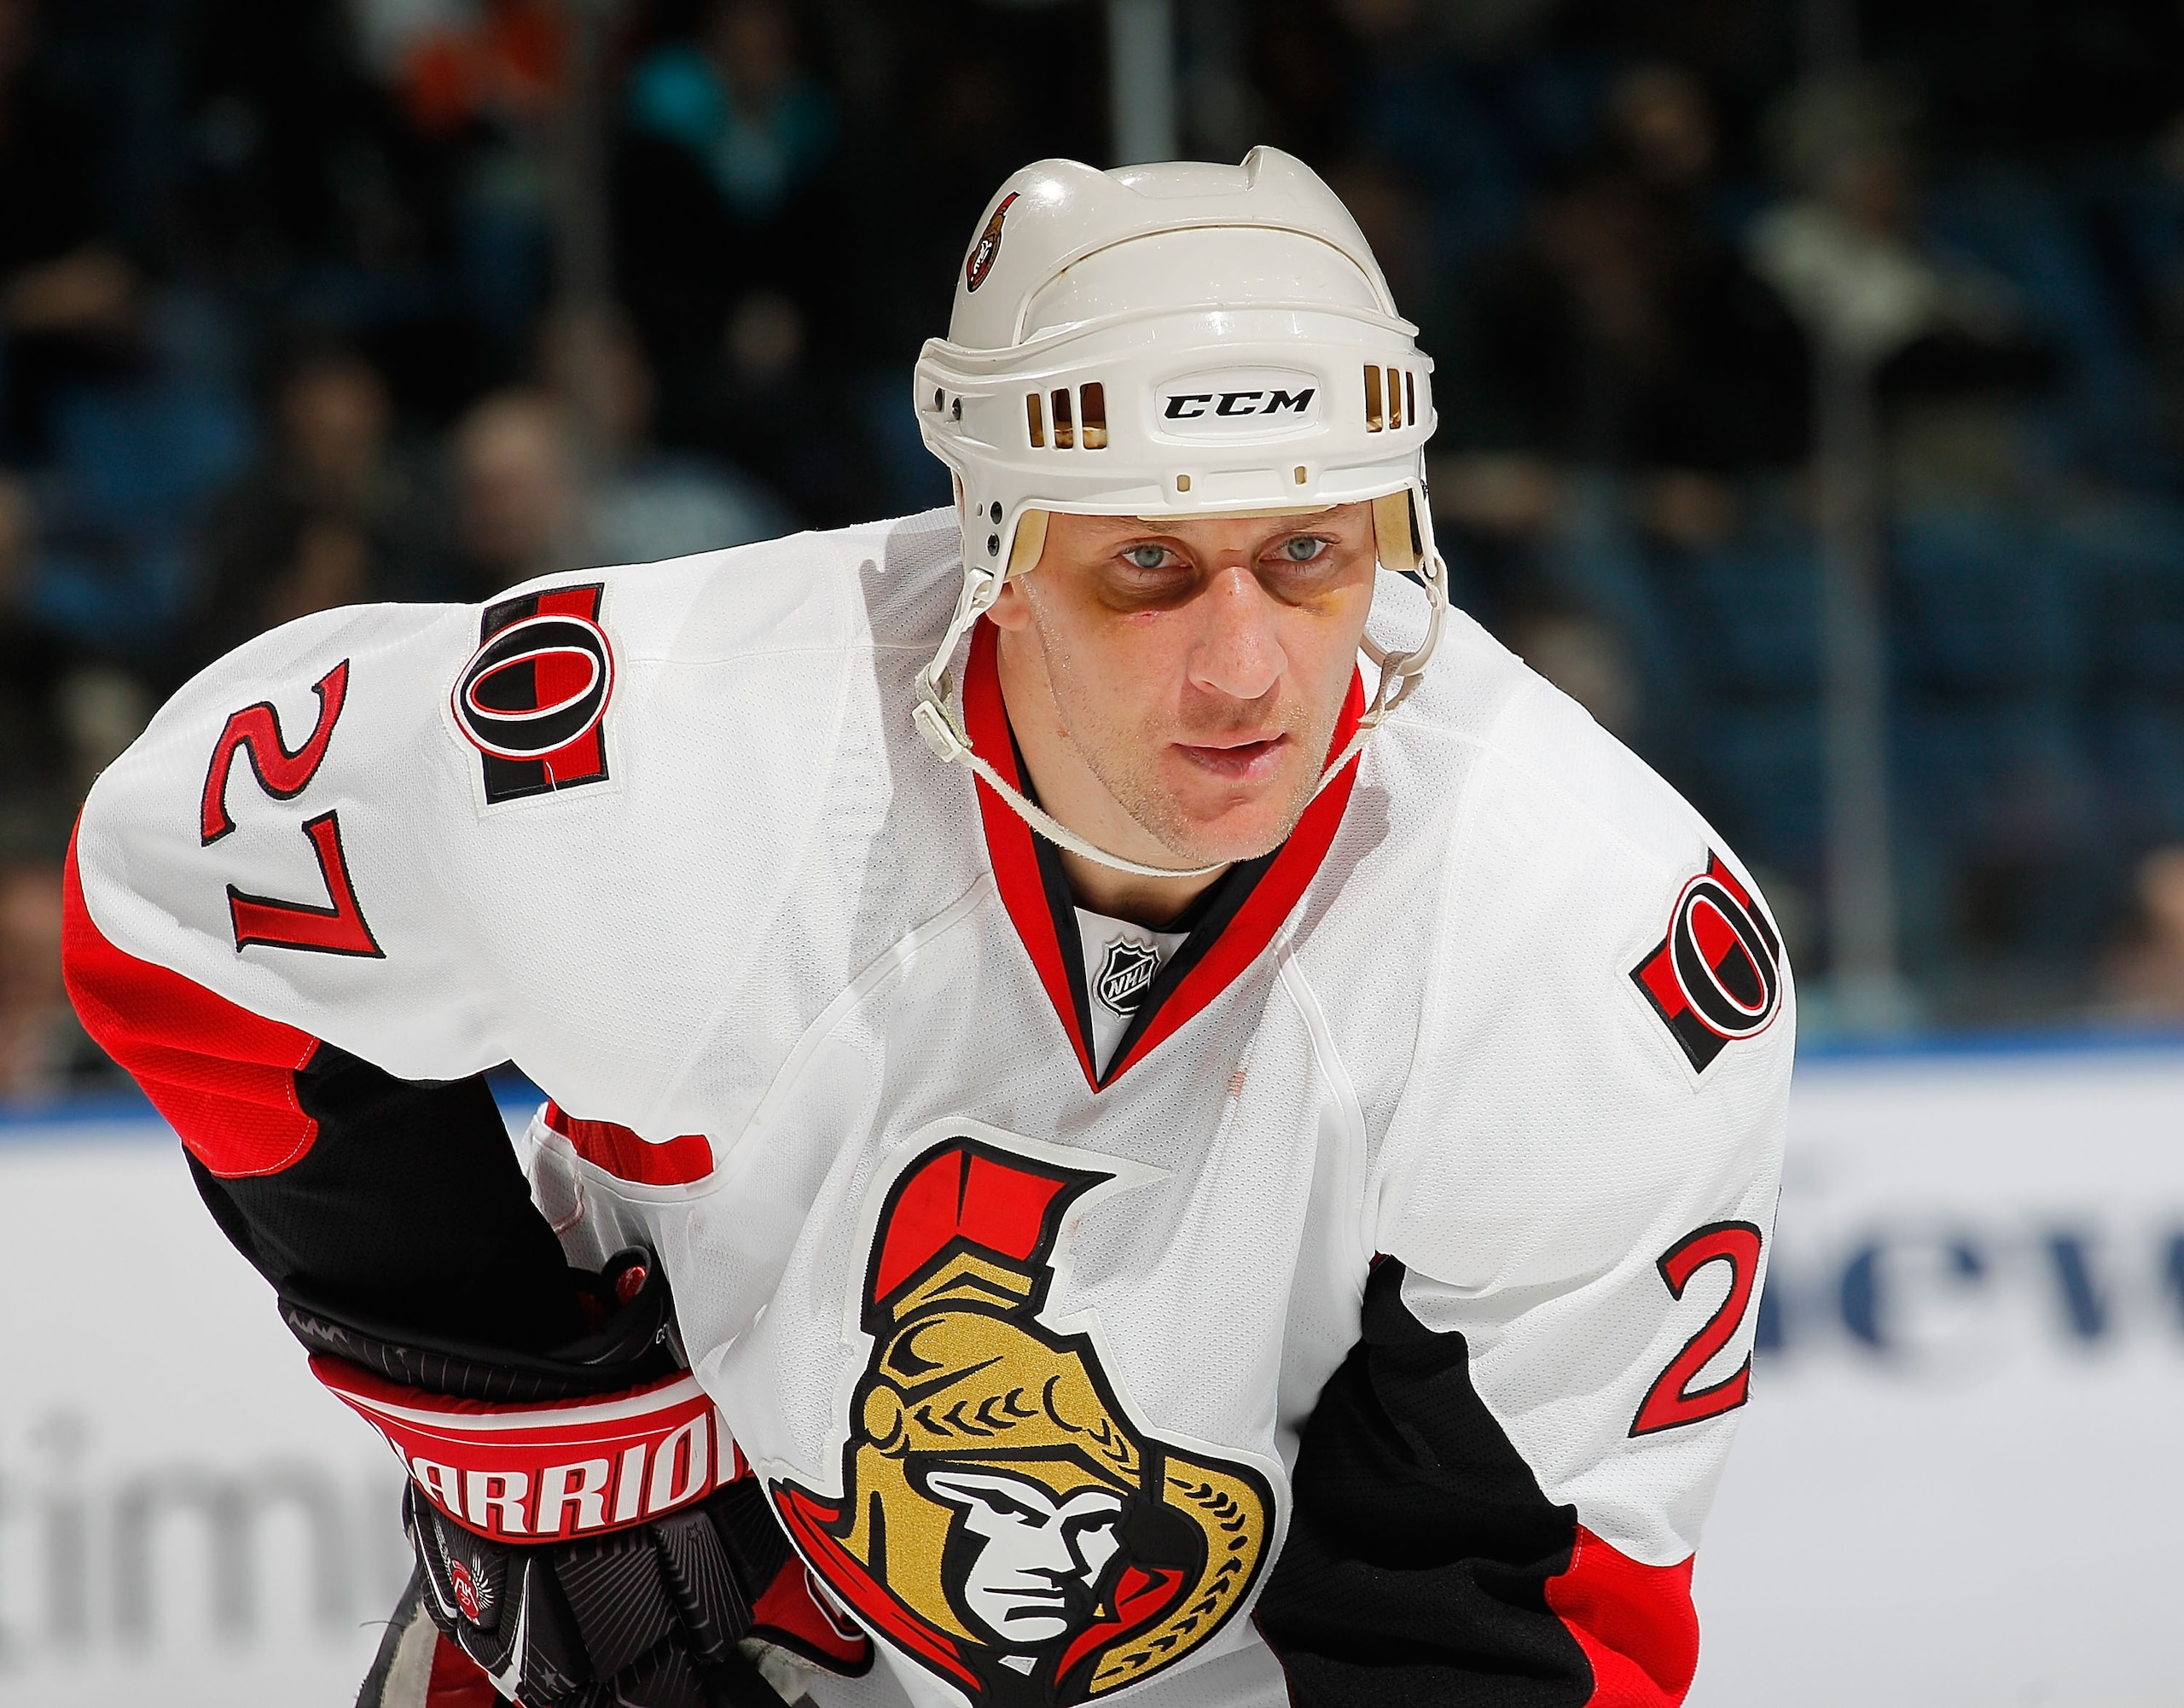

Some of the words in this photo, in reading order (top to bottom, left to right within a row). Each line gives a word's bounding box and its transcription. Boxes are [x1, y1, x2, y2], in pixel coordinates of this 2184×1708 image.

[1164, 388, 1316, 419] CCM
[200, 658, 386, 960] 27
[1107, 962, 1149, 998] NHL
[1628, 1220, 1763, 1439] 2
[368, 1404, 752, 1534] ARRIO
